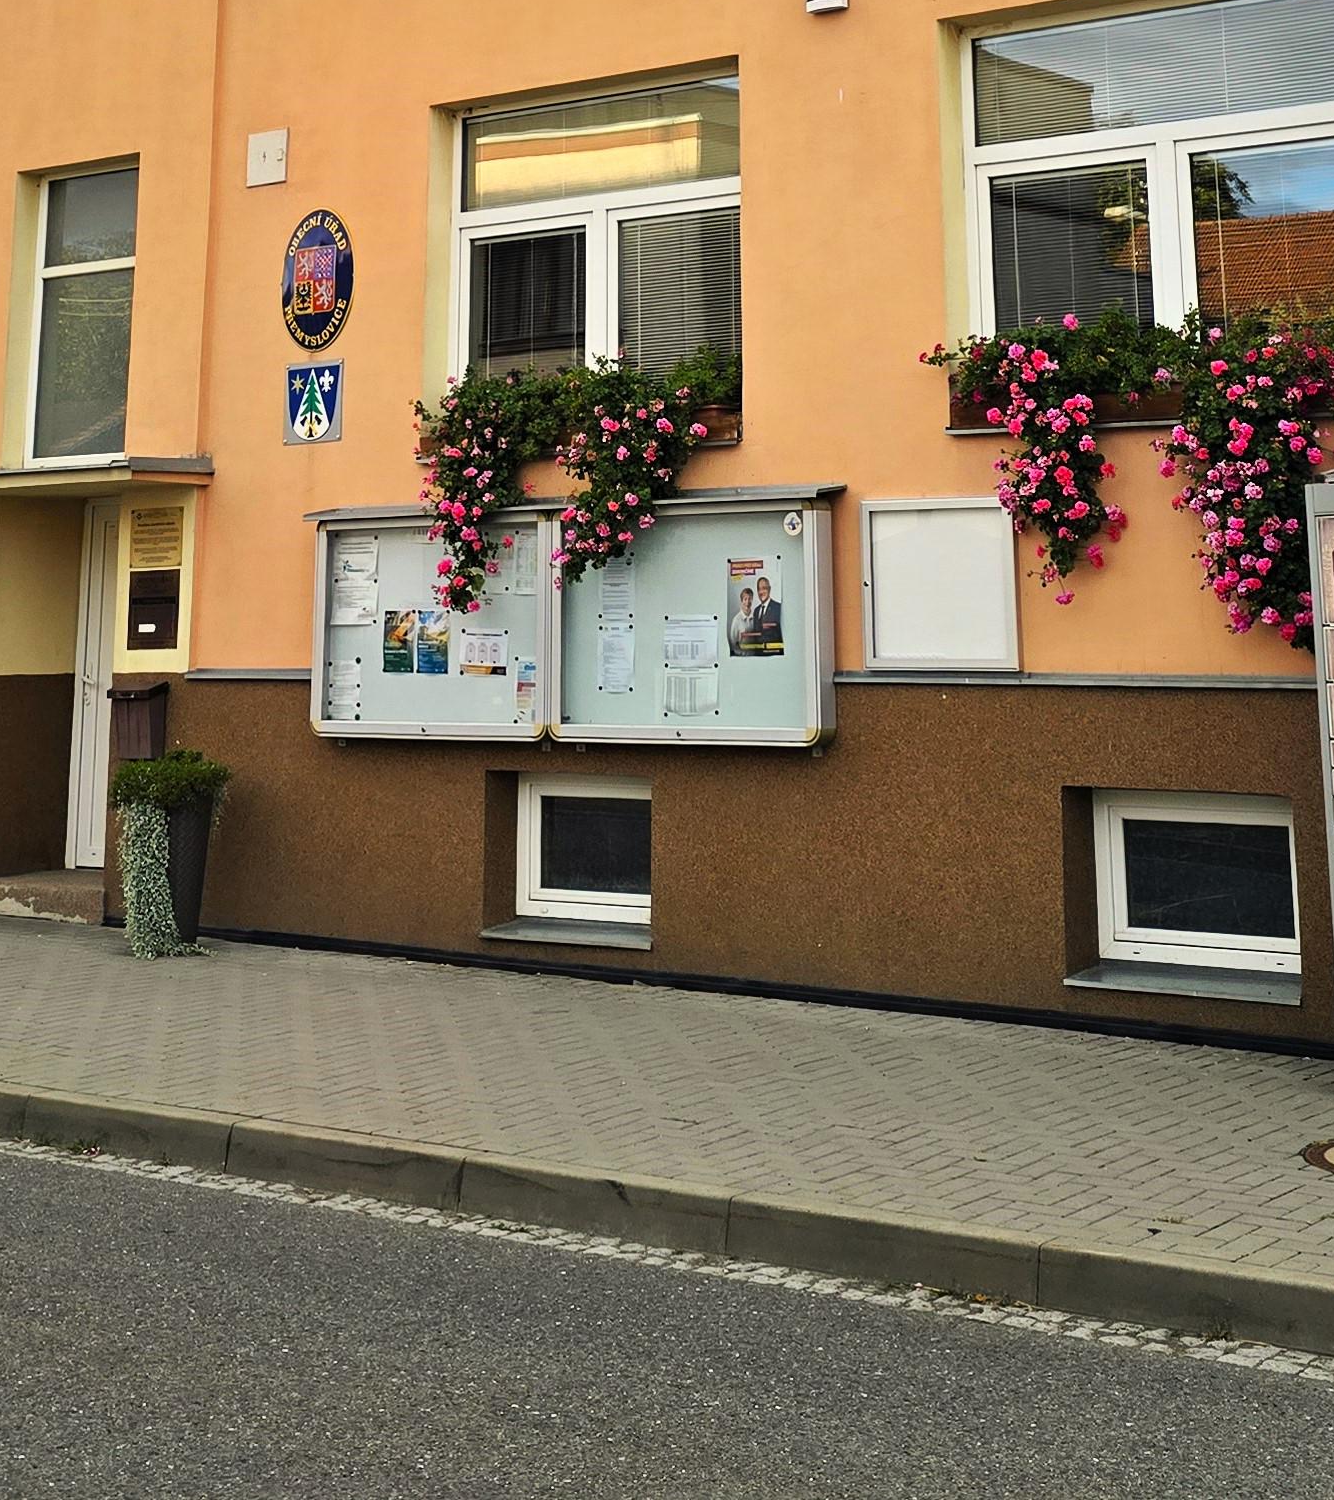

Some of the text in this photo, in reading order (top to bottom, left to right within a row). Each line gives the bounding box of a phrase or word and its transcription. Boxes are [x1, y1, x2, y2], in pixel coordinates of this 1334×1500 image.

[288, 212, 347, 257] OBECNÍ ÚŘAD
[284, 298, 347, 347] PŘEMYSLOVICE
